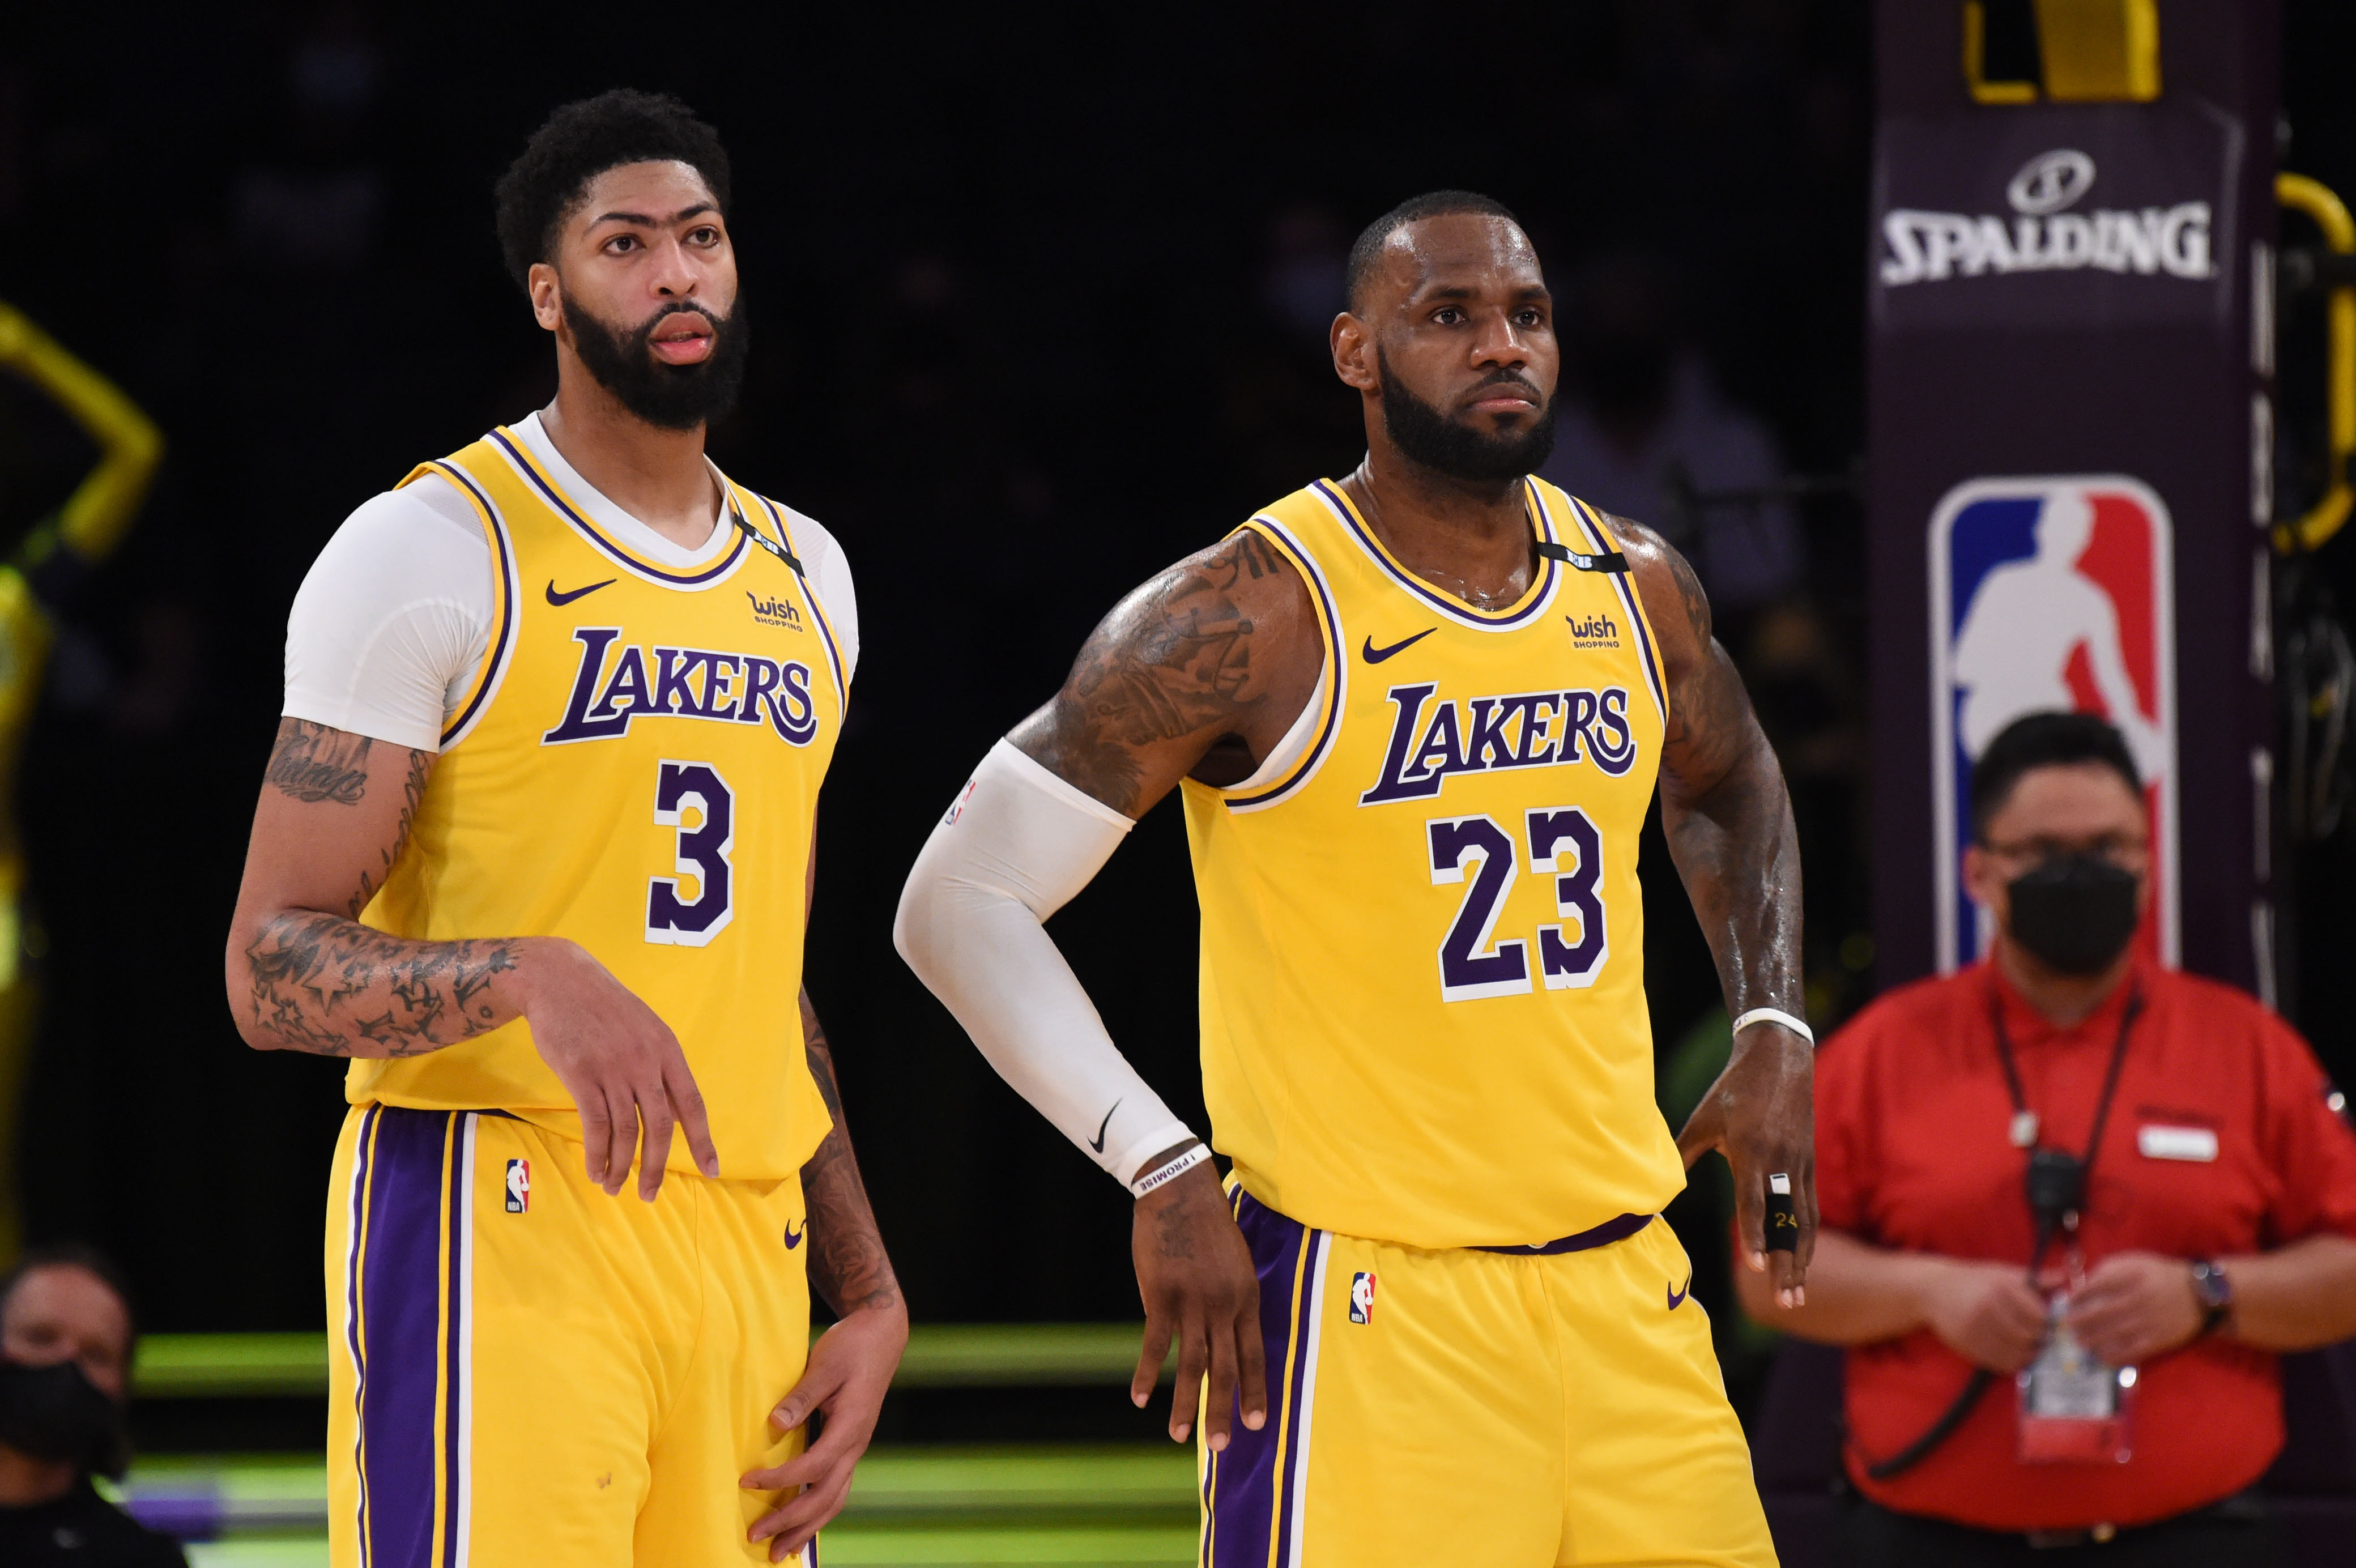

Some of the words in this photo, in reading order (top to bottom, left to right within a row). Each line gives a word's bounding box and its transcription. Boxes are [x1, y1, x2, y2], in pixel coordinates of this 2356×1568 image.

[1880, 202, 2212, 286] SPALDING
[746, 591, 799, 623] wish
[755, 616, 803, 633] SHOPPING
[1566, 614, 1617, 638] wish
[540, 626, 819, 748] LAKERS
[1357, 680, 1637, 808] LAKERS
[645, 758, 735, 948] 3
[1425, 805, 1609, 1003] 23
[1140, 1158, 1189, 1191] PROMISE
[507, 1201, 520, 1212] NBA
[1775, 1212, 1798, 1228] 24
[1351, 1313, 1363, 1323] NBA
